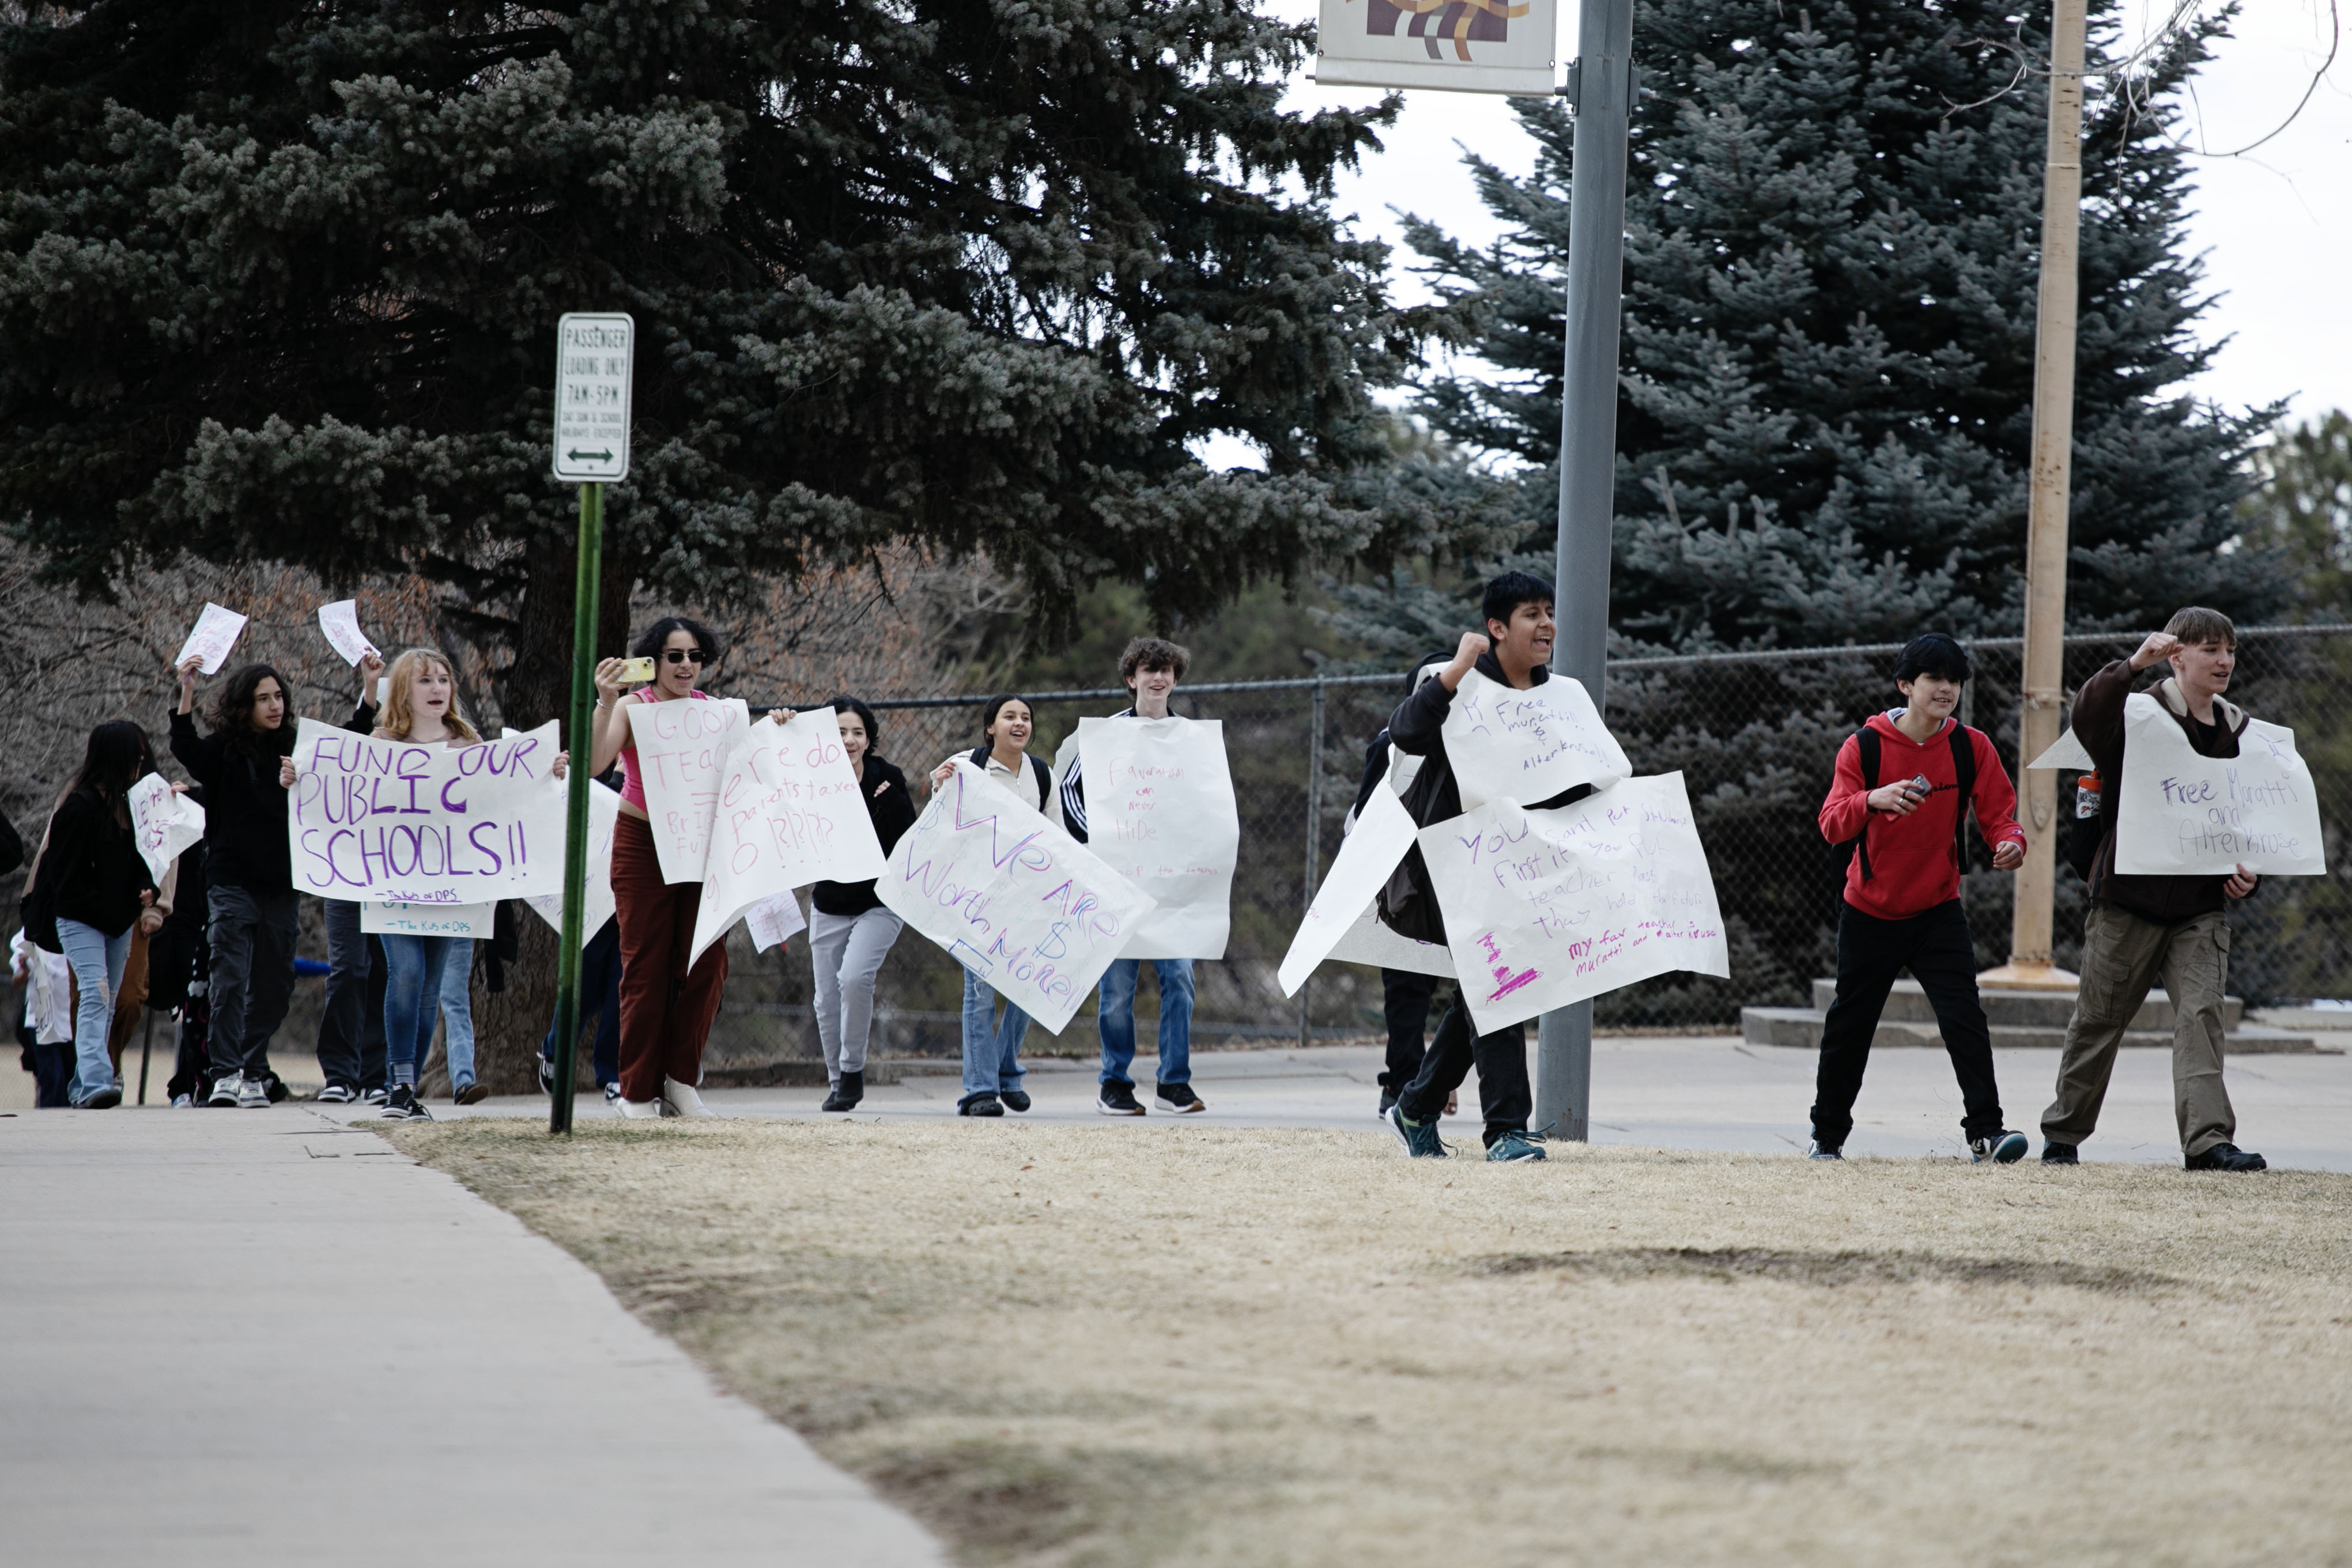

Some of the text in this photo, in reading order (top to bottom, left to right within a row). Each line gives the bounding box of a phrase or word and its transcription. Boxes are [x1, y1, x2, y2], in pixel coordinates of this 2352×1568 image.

[567, 328, 625, 348] PASSENGER
[565, 356, 599, 376] LOADING
[654, 705, 737, 739] GOOD
[1496, 699, 1546, 724] Free
[458, 738, 538, 779] OUR
[806, 732, 841, 768] do
[296, 772, 467, 826] PUBLIC
[2160, 776, 2218, 806] Free
[2208, 804, 2243, 830] and
[301, 821, 527, 887] SCHOOLS!!
[435, 888, 458, 901] DPS
[1633, 934, 1648, 947] and
